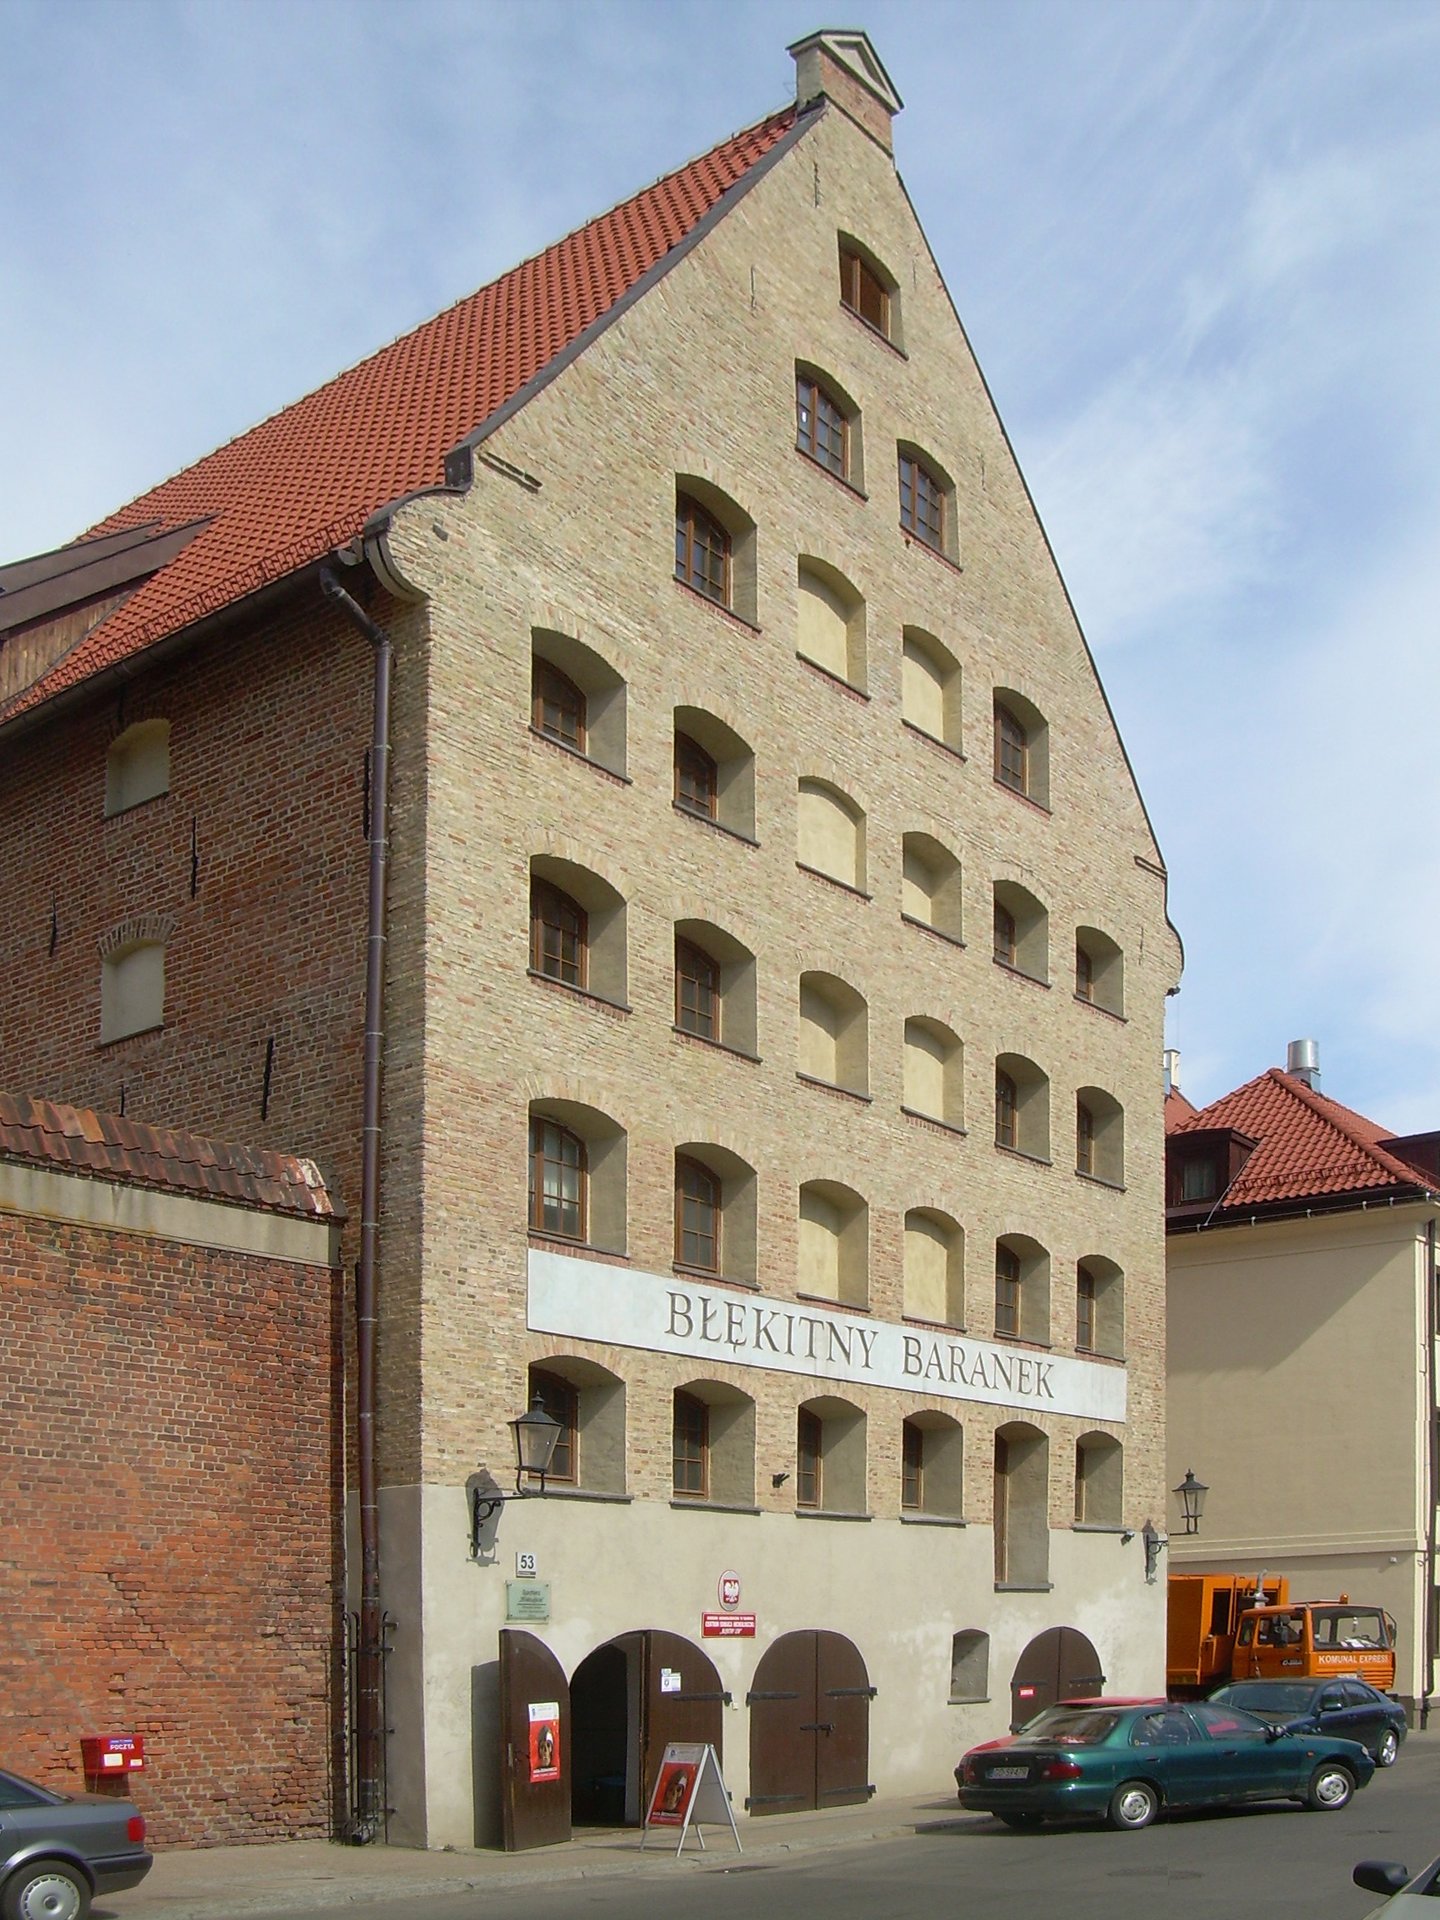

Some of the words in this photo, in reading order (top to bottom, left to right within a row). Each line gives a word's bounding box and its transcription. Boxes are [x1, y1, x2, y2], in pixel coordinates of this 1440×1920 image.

[664, 1291, 879, 1370] BŁĘKITNY
[902, 1336, 1055, 1399] BARANEK
[520, 1555, 535, 1570] 53
[1318, 1655, 1358, 1664] KOMUNAL
[1359, 1655, 1389, 1664] EXPRESS
